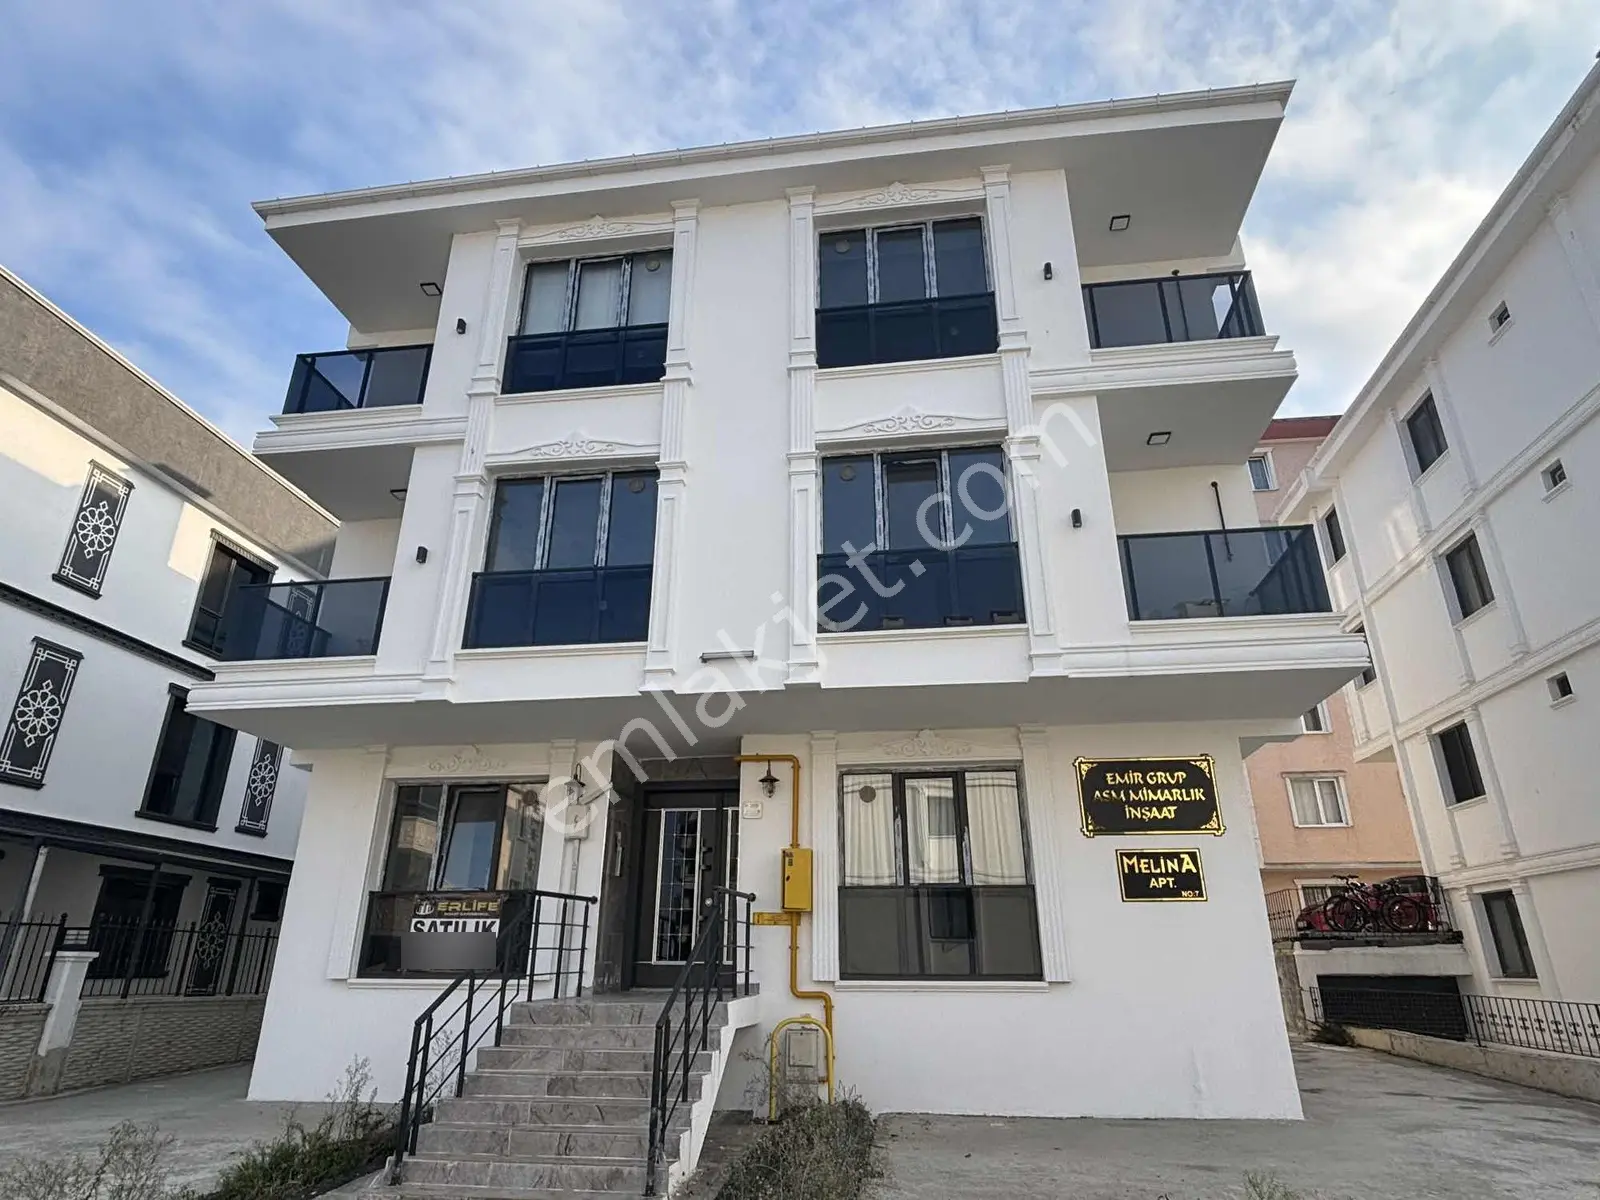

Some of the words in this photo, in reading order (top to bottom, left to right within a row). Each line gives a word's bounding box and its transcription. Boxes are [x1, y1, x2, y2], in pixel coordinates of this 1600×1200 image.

[1106, 770, 1144, 785] EMİR
[1146, 771, 1186, 785] GRUP
[1129, 787, 1206, 802] MİMARLIK
[1125, 804, 1178, 822] İNŞAAT
[1122, 854, 1197, 874] MELİNA
[1149, 877, 1177, 888] APT.
